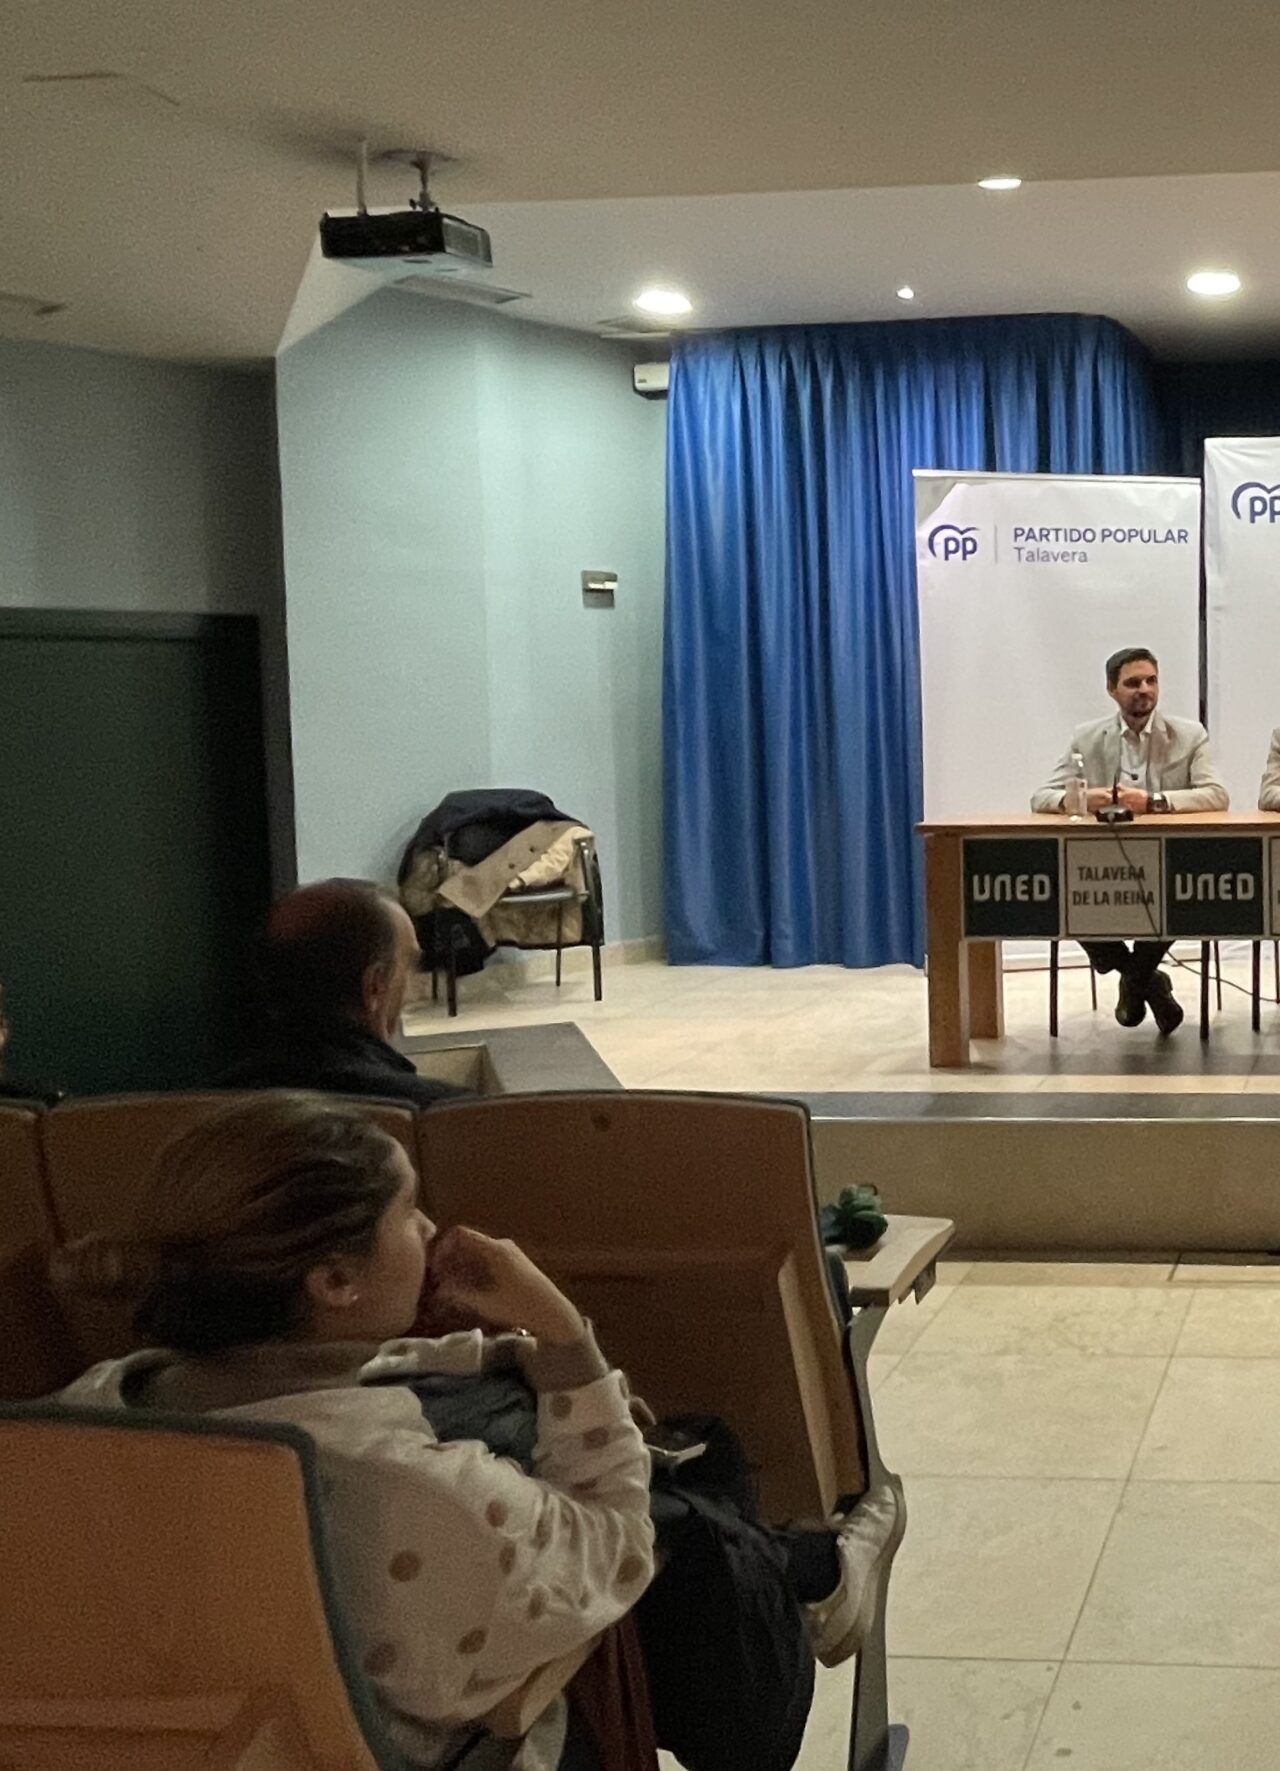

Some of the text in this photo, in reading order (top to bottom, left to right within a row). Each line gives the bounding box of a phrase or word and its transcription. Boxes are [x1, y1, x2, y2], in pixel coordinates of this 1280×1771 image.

[1013, 527, 1189, 544] PARTIDO POPULAR
[1013, 547, 1088, 563] Talavera
[1078, 866, 1146, 881] TALAVERA
[972, 873, 1051, 901] UNED
[1175, 872, 1254, 901] UNED
[1073, 890, 1155, 906] DE LA REINA
